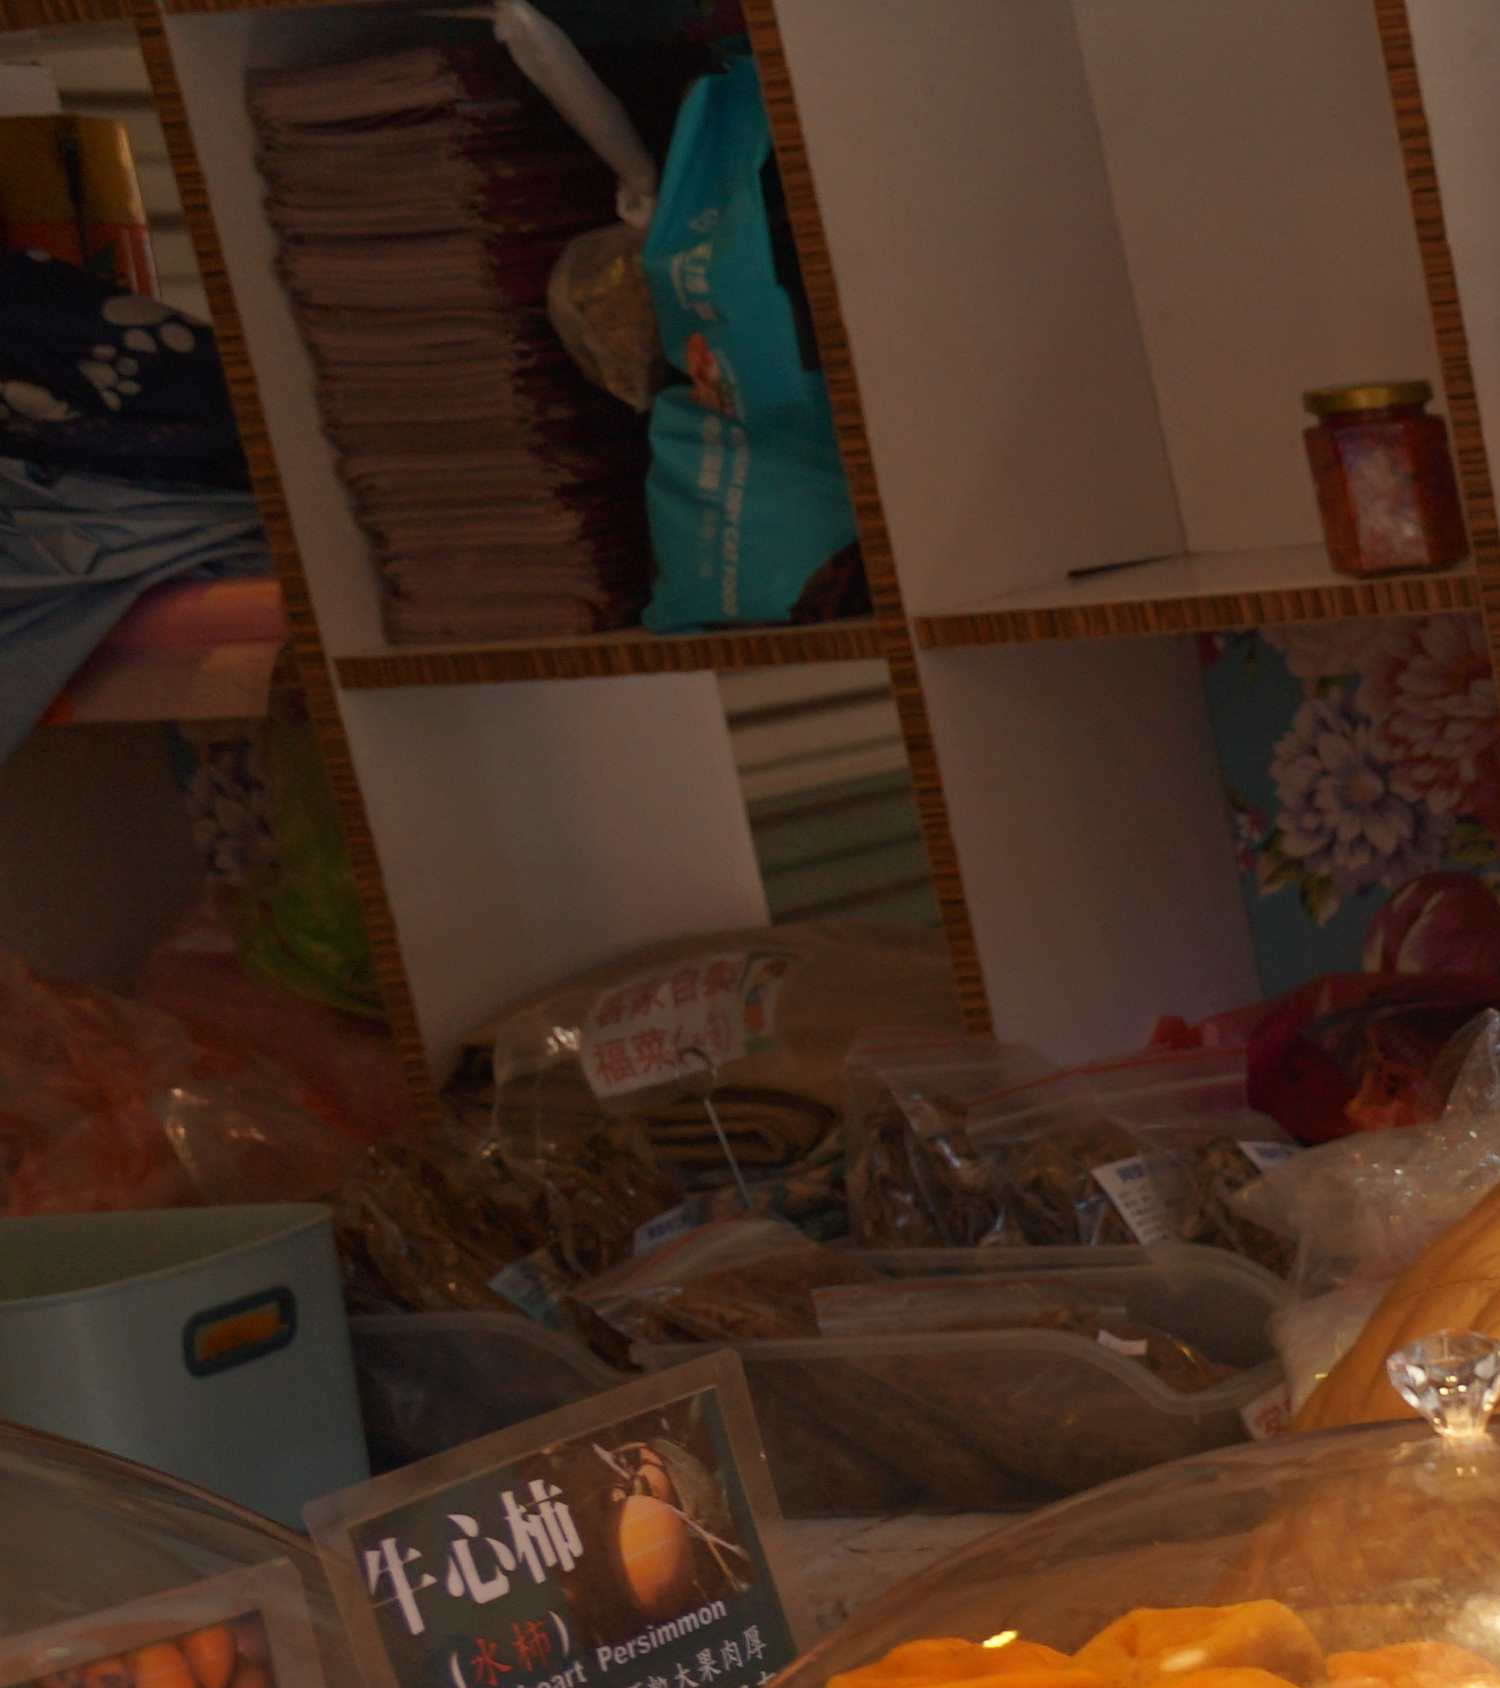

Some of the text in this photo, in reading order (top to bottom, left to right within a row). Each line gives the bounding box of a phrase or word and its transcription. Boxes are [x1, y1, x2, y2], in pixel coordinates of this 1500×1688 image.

[364, 1477, 586, 1636] 牛心柿
[596, 1601, 728, 1674] Persimmon
